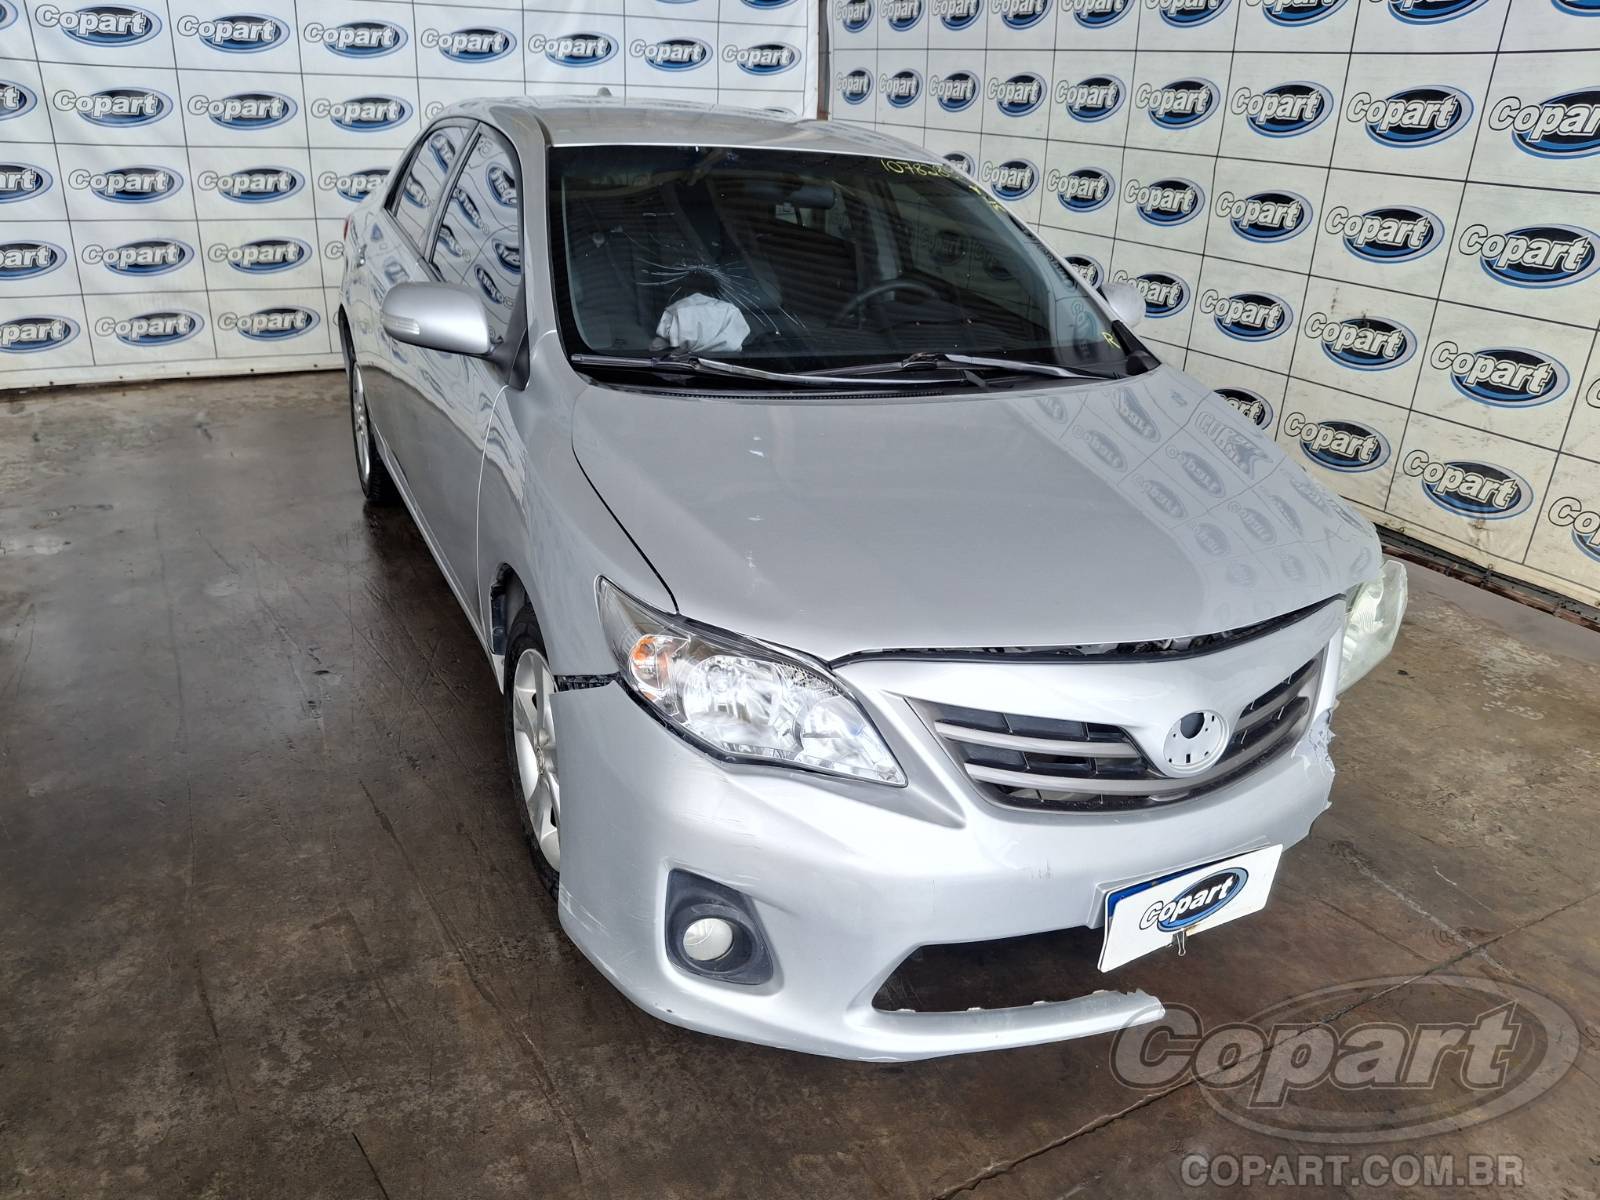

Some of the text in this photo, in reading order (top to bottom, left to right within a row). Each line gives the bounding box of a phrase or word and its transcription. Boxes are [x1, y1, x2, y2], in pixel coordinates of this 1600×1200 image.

[35, 4, 147, 35] Copart
[177, 15, 276, 43] Copart
[304, 23, 394, 48] Copart
[421, 28, 504, 54] Copart
[529, 34, 607, 58] Copart
[630, 39, 702, 63] Copart
[722, 45, 794, 66] Copart
[835, 72, 869, 98] Copart
[879, 72, 918, 100] Copart
[928, 75, 975, 103] Copart
[987, 77, 1041, 106] Copart
[1055, 79, 1119, 110] Copart
[1135, 81, 1211, 117] Copart
[53, 90, 159, 117] Copart
[188, 95, 285, 120] Copart
[311, 98, 401, 123] Copart
[1231, 87, 1322, 124] Copart
[1346, 92, 1461, 134] Copart
[1489, 96, 1600, 142] Copar
[69, 169, 169, 197] Copart
[198, 171, 293, 195] Copart
[318, 171, 386, 196] Copa
[981, 160, 1033, 192] Copart
[1047, 169, 1107, 200] Copart
[1124, 179, 1197, 213] Copart
[1215, 191, 1301, 228] Copart
[1325, 206, 1432, 248] Copart
[82, 242, 182, 268] Copart
[208, 240, 299, 264] Copart
[1459, 224, 1590, 272] Copart
[218, 308, 308, 334] Copart
[1200, 289, 1282, 329] Copart
[0, 319, 66, 347] part
[95, 312, 192, 341] Copart
[1304, 312, 1406, 359] Copart
[1430, 341, 1555, 395] Copart
[1284, 411, 1379, 463] Copart
[1403, 449, 1522, 509] Copart
[1139, 876, 1235, 930] Copart
